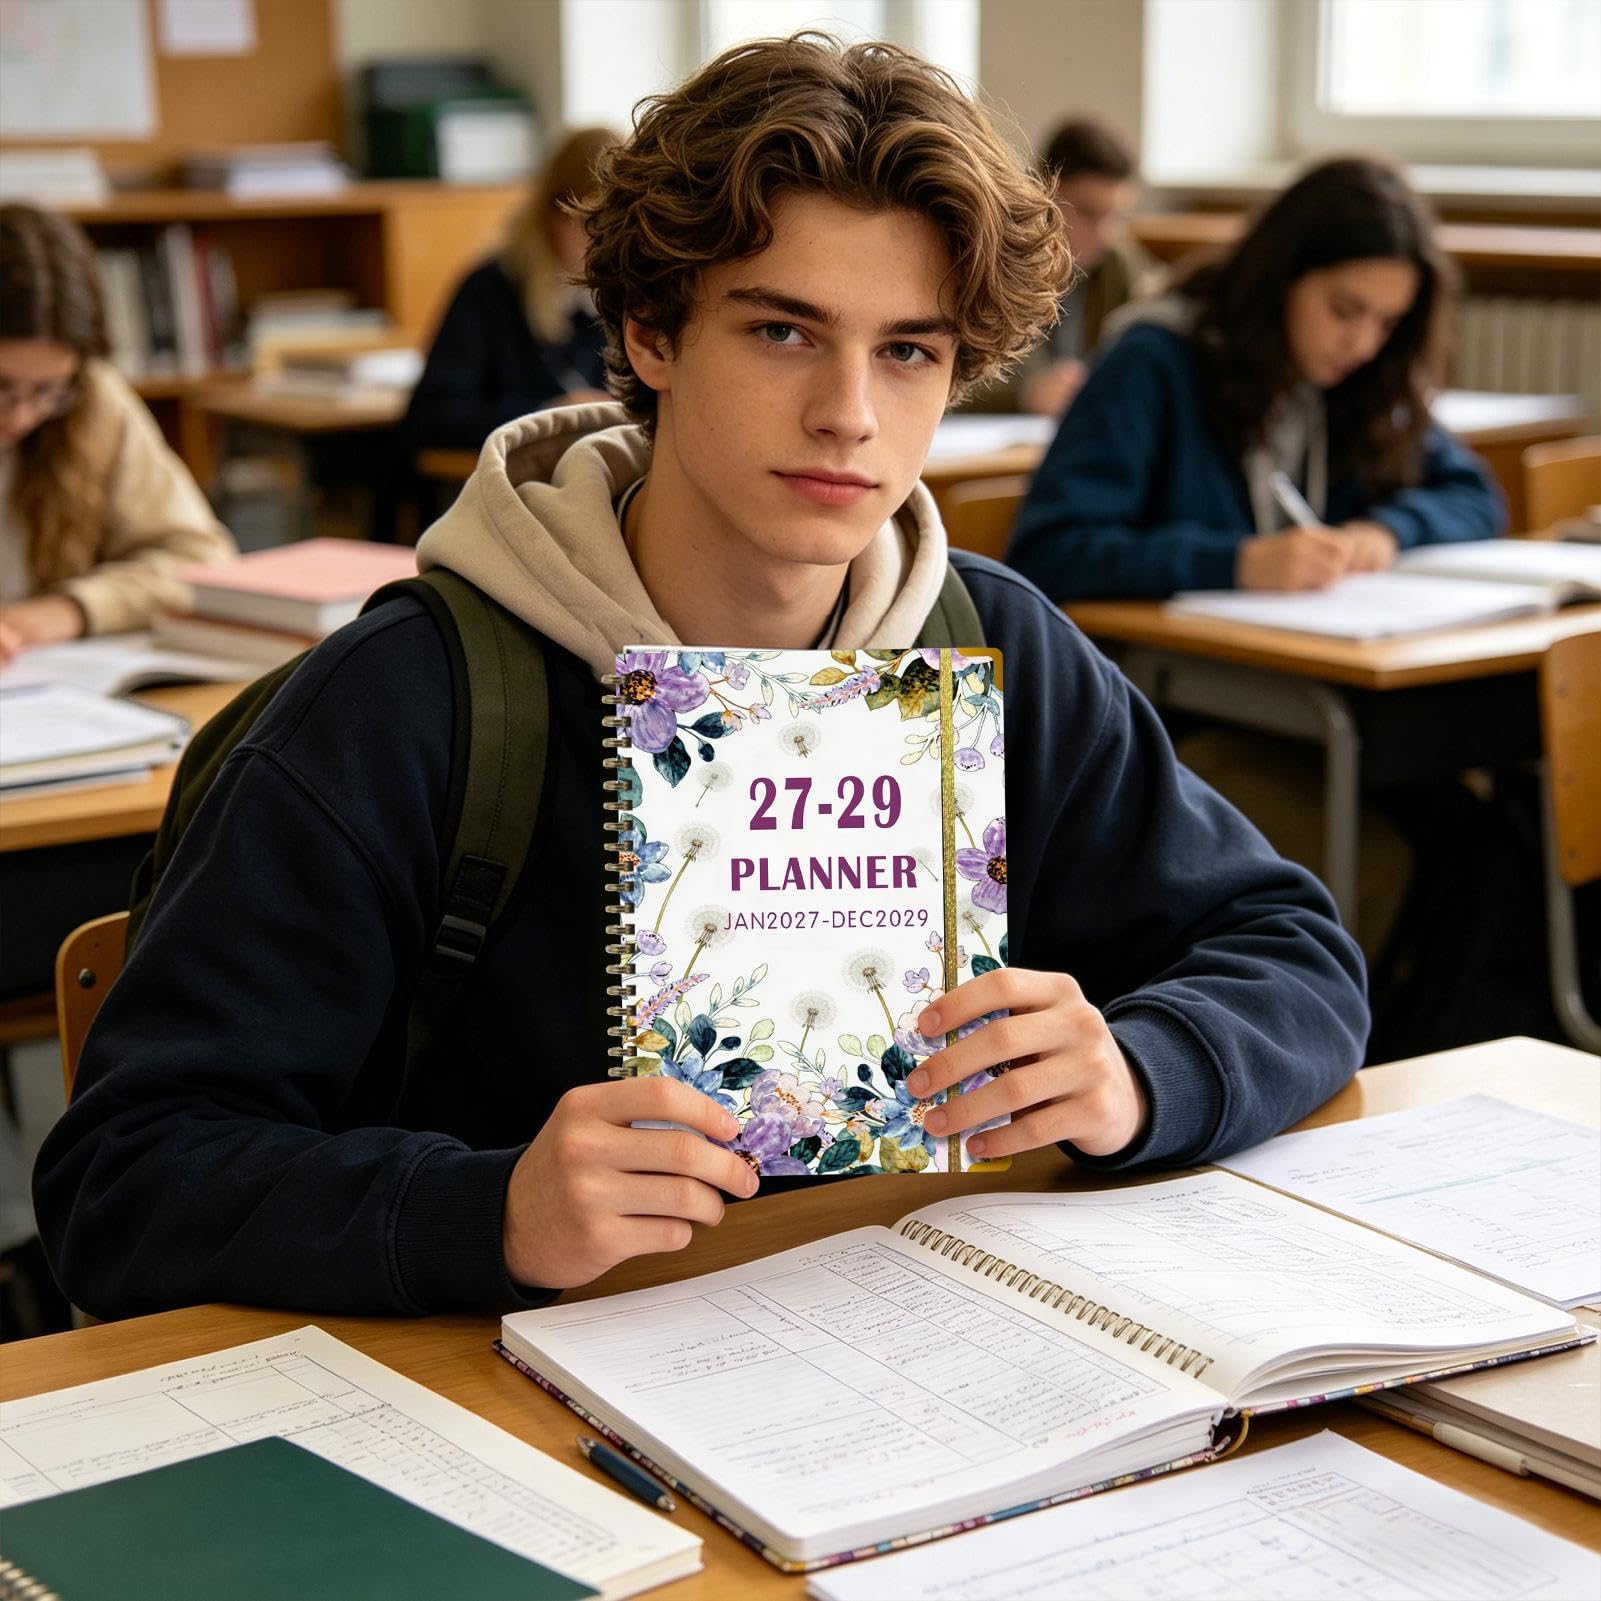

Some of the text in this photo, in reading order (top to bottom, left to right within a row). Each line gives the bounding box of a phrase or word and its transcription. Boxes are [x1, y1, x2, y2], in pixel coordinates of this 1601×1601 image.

[749, 774, 902, 831] 27-29
[730, 854, 918, 892] PLANNER
[723, 909, 929, 930] JAN2027-DEC2029
